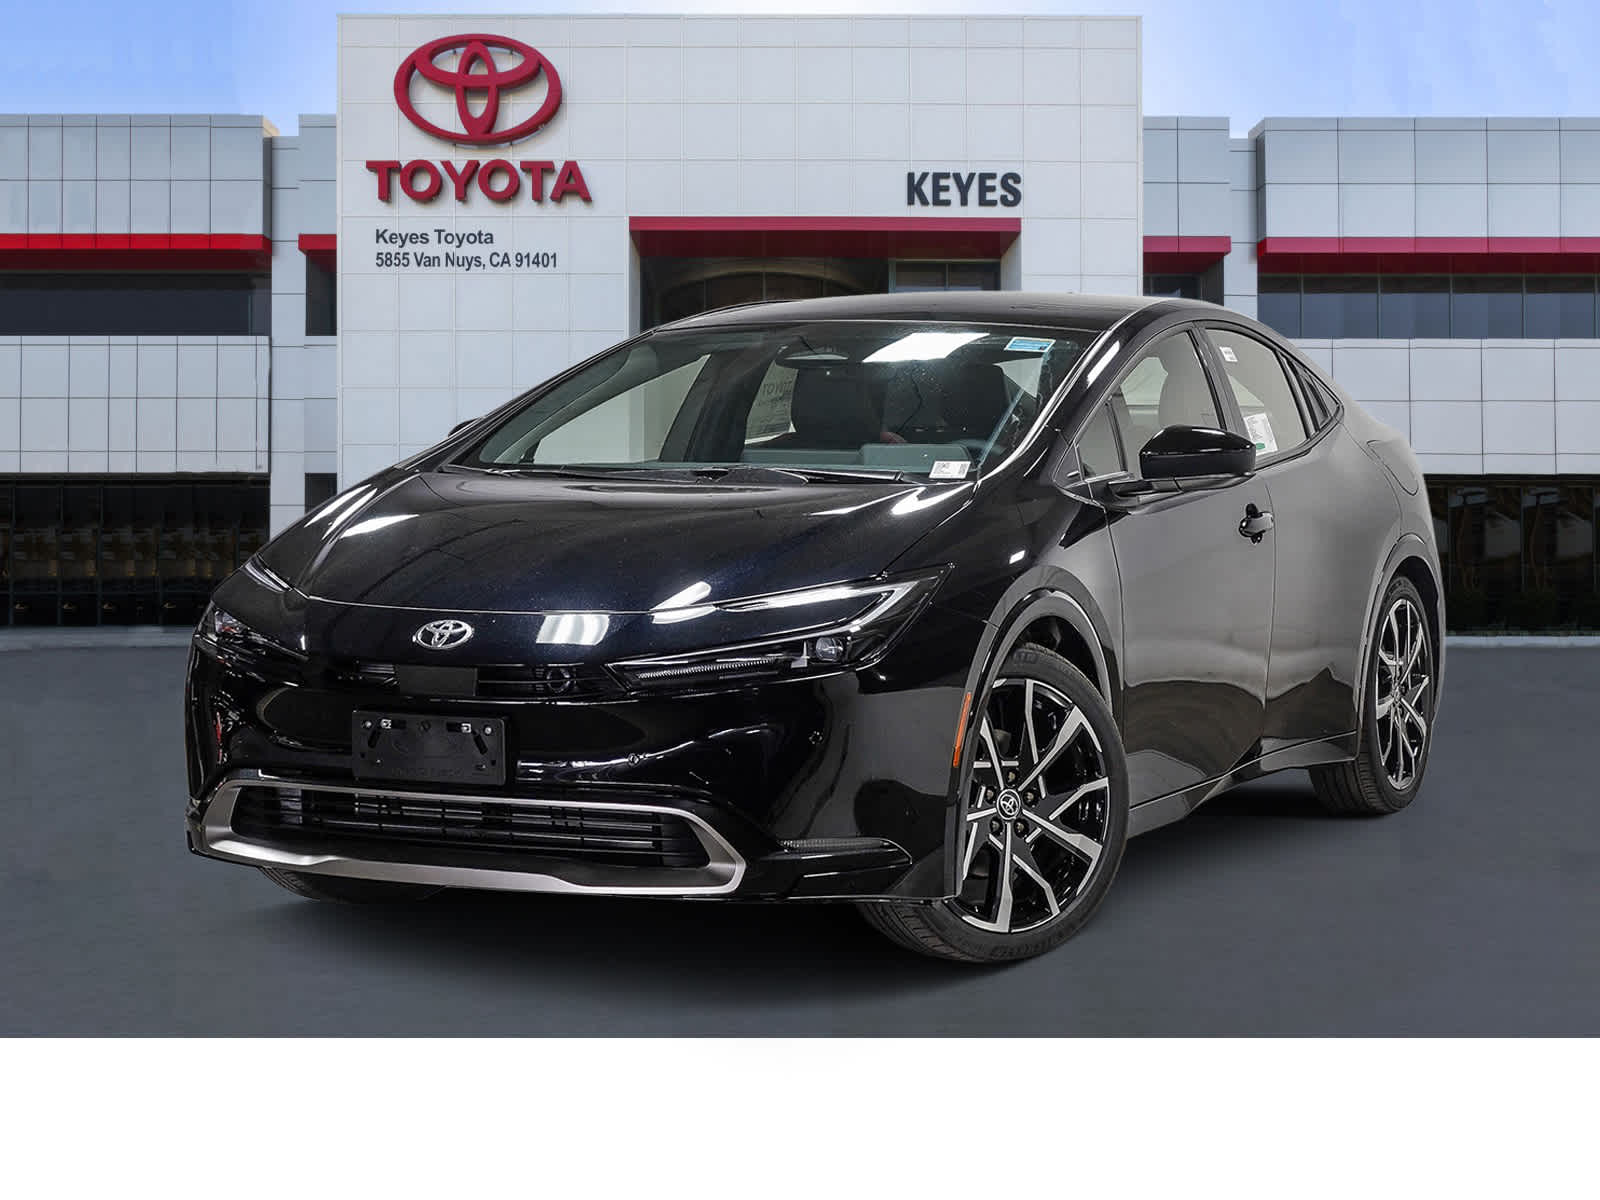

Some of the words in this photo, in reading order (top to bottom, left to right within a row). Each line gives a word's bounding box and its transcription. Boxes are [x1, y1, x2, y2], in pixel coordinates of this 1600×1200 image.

[366, 159, 592, 202] TOYOTA
[907, 172, 1022, 207] KEYES
[375, 229, 430, 248] Keyes
[434, 229, 494, 248] Toyota
[375, 252, 410, 268] 5855
[413, 252, 441, 268] Van
[445, 252, 486, 271] Nuys,
[489, 252, 511, 268] CA
[515, 252, 558, 268] 91401
